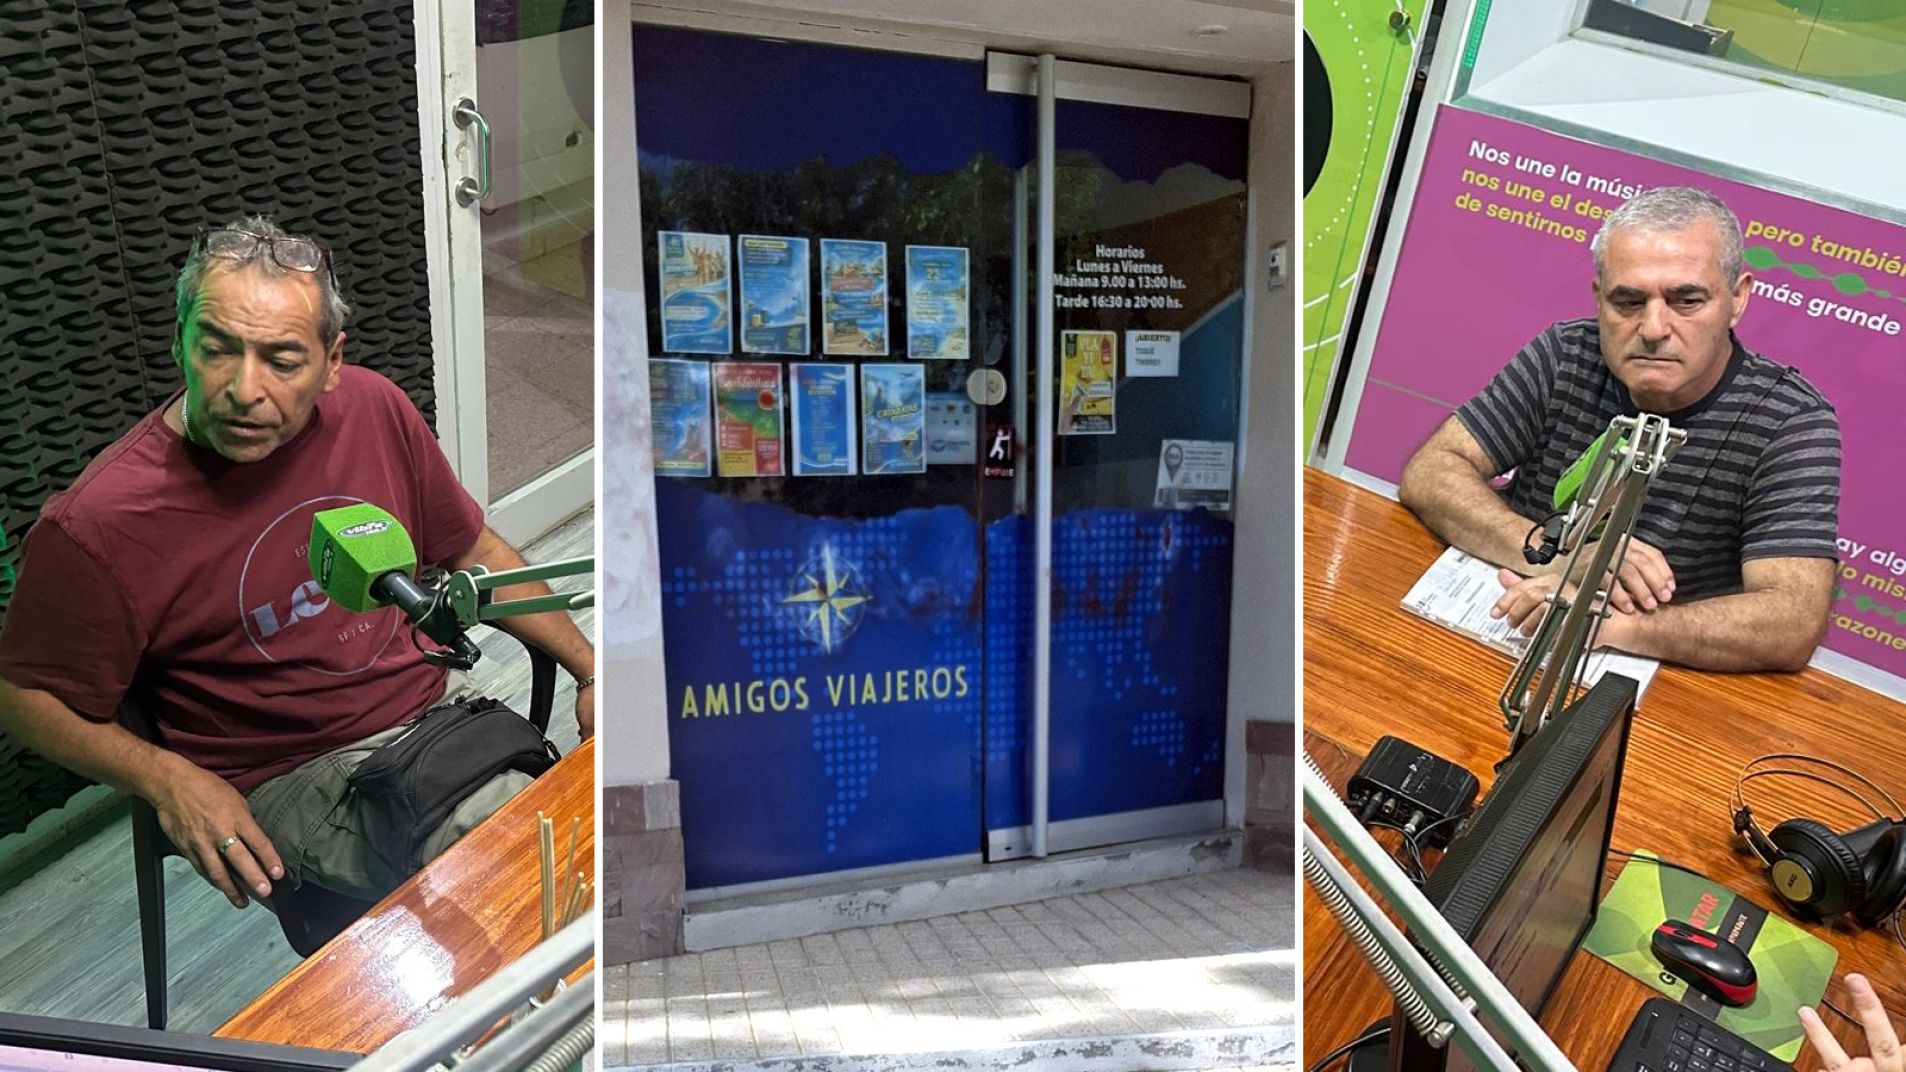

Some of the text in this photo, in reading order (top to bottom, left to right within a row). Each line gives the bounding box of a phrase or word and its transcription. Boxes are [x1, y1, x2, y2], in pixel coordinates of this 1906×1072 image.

[1469, 140, 1645, 200] Nos une la músi
[1462, 168, 1500, 191] nos
[1505, 180, 1545, 203] une
[1550, 193, 1571, 211] el
[1455, 192, 1482, 212] de
[1486, 202, 1588, 243] sentirnos
[1745, 220, 1805, 247] pero
[1096, 244, 1145, 259] Horarios
[1077, 259, 1164, 274] Lunes a Viernes
[1052, 274, 1186, 289] Mañana 9.00 a 13:00 hs.
[1055, 294, 1089, 308] Tarde
[1091, 295, 1123, 309] 16:30
[1125, 298, 1132, 308] a
[1166, 295, 1183, 309] hs.
[1751, 279, 1901, 336] más grande
[1862, 573, 1906, 600] mis
[682, 666, 968, 718] AMIGOS VIAJEROS
